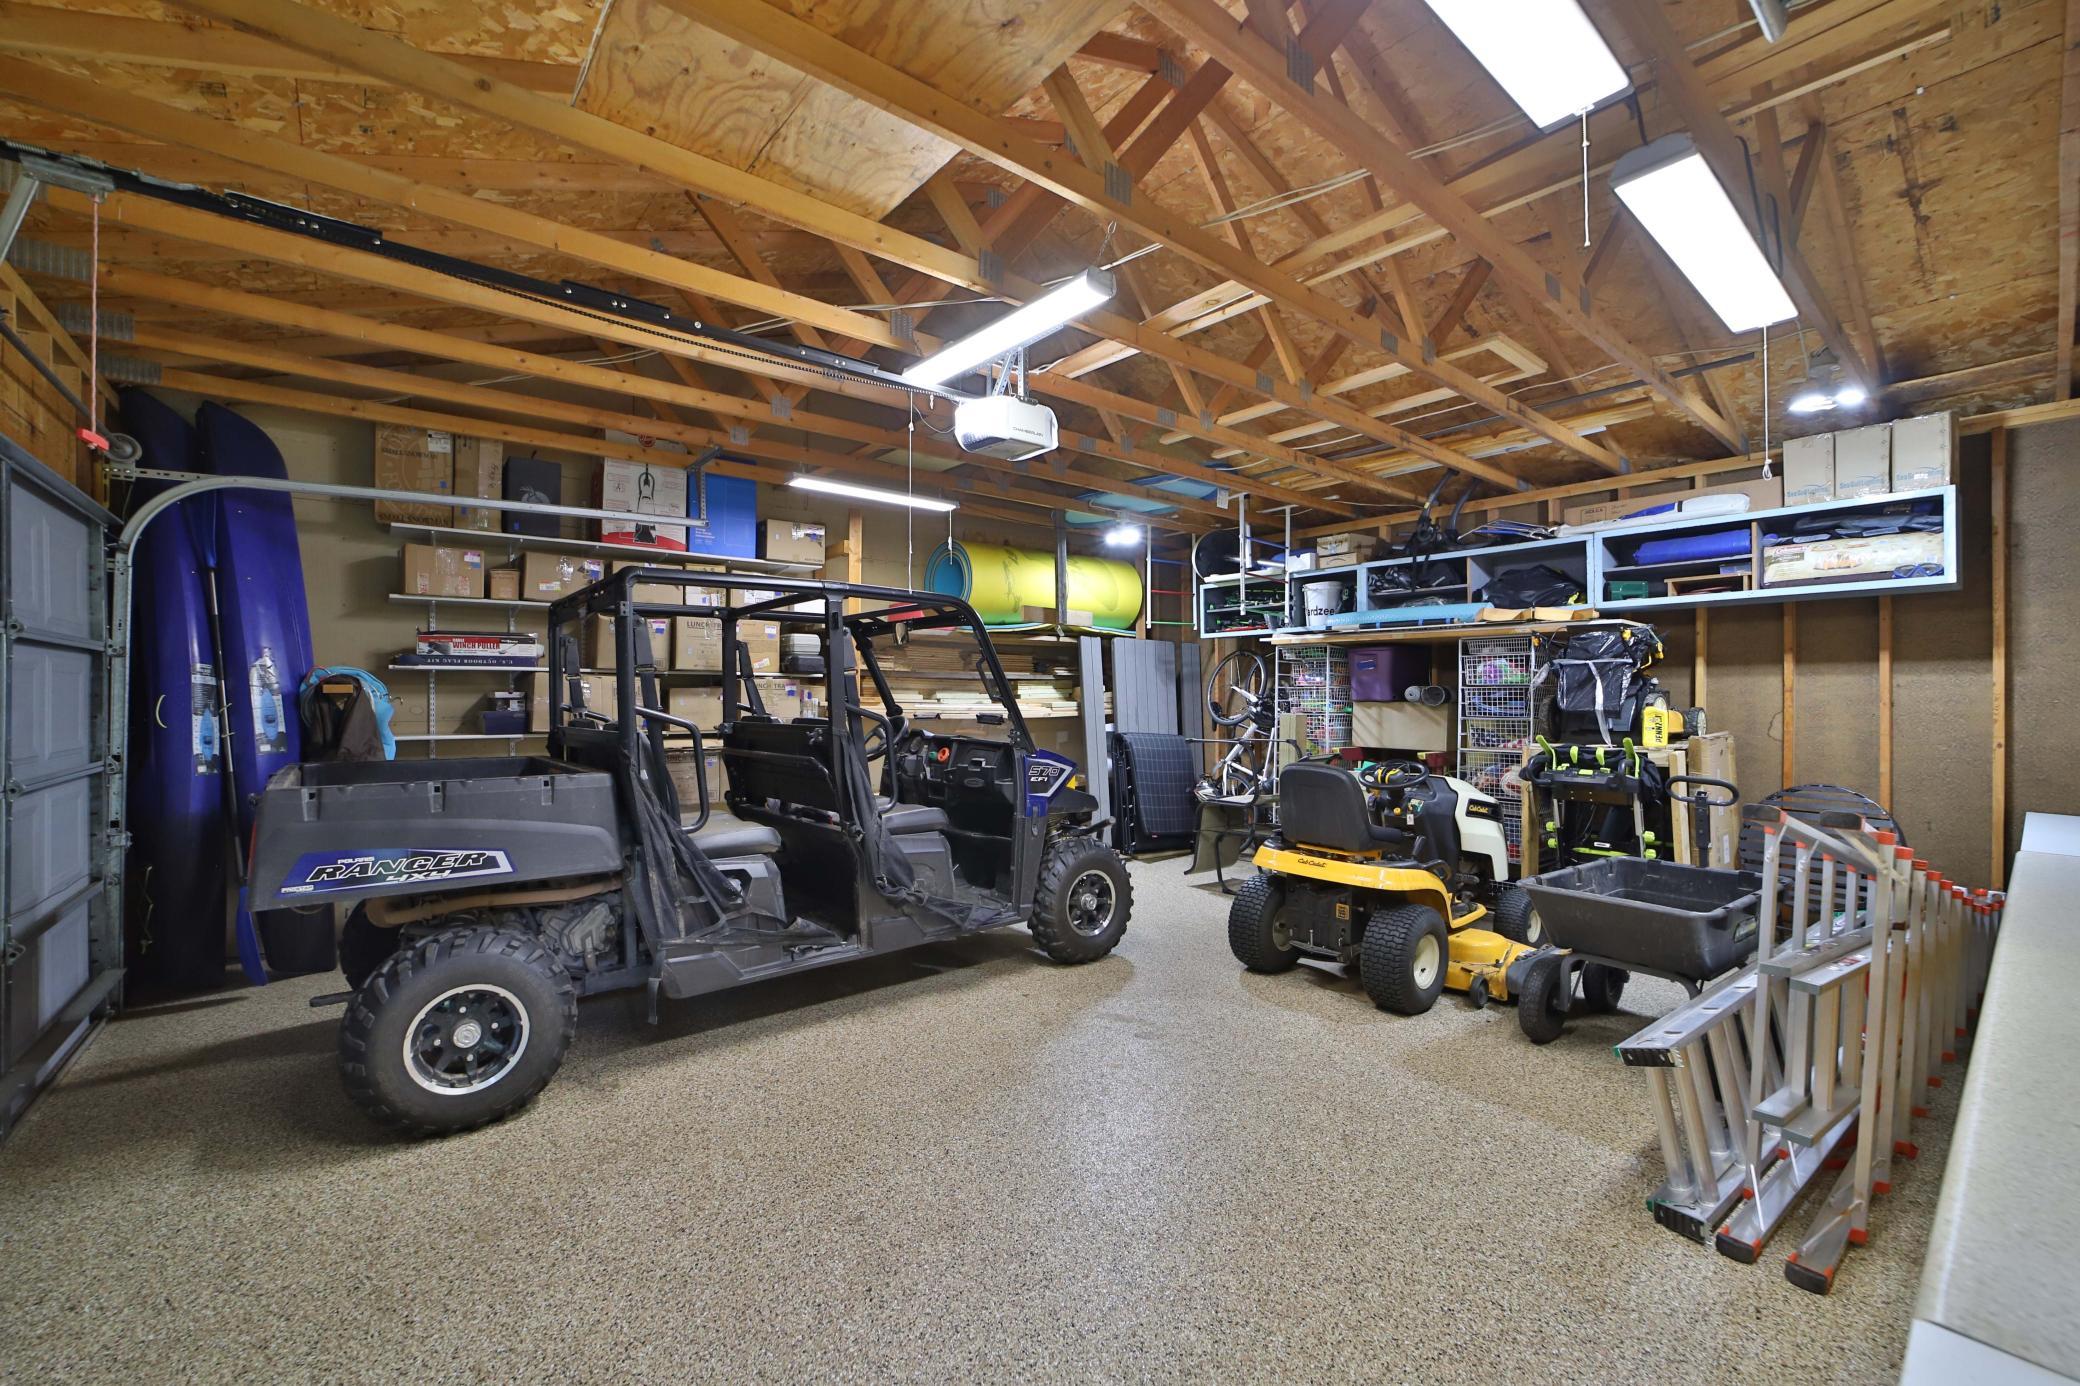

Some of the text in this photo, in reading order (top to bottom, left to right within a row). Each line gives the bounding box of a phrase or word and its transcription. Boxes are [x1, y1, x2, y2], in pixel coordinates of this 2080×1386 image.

[452, 641, 476, 650] WINCH
[477, 642, 500, 651] PULLER
[1028, 765, 1061, 777] 570
[337, 856, 375, 865] POLARIS
[306, 851, 487, 883] RANGER
